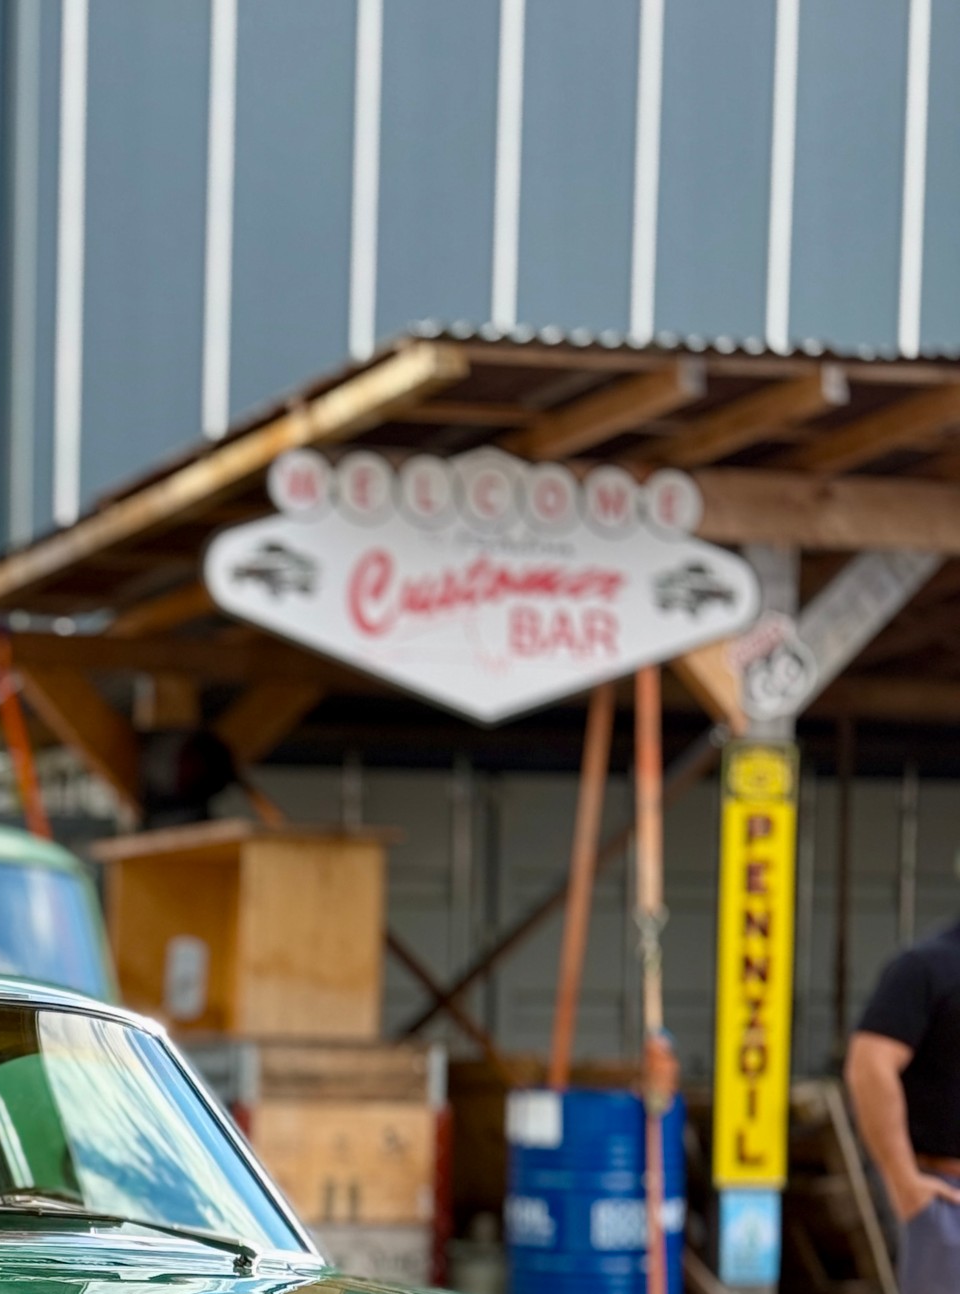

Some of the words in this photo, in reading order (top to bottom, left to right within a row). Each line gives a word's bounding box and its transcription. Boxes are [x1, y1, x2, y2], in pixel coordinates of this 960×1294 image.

[282, 465, 680, 528] WELCOME
[508, 604, 619, 657] BAR
[737, 813, 773, 1167] PENNZOIL
